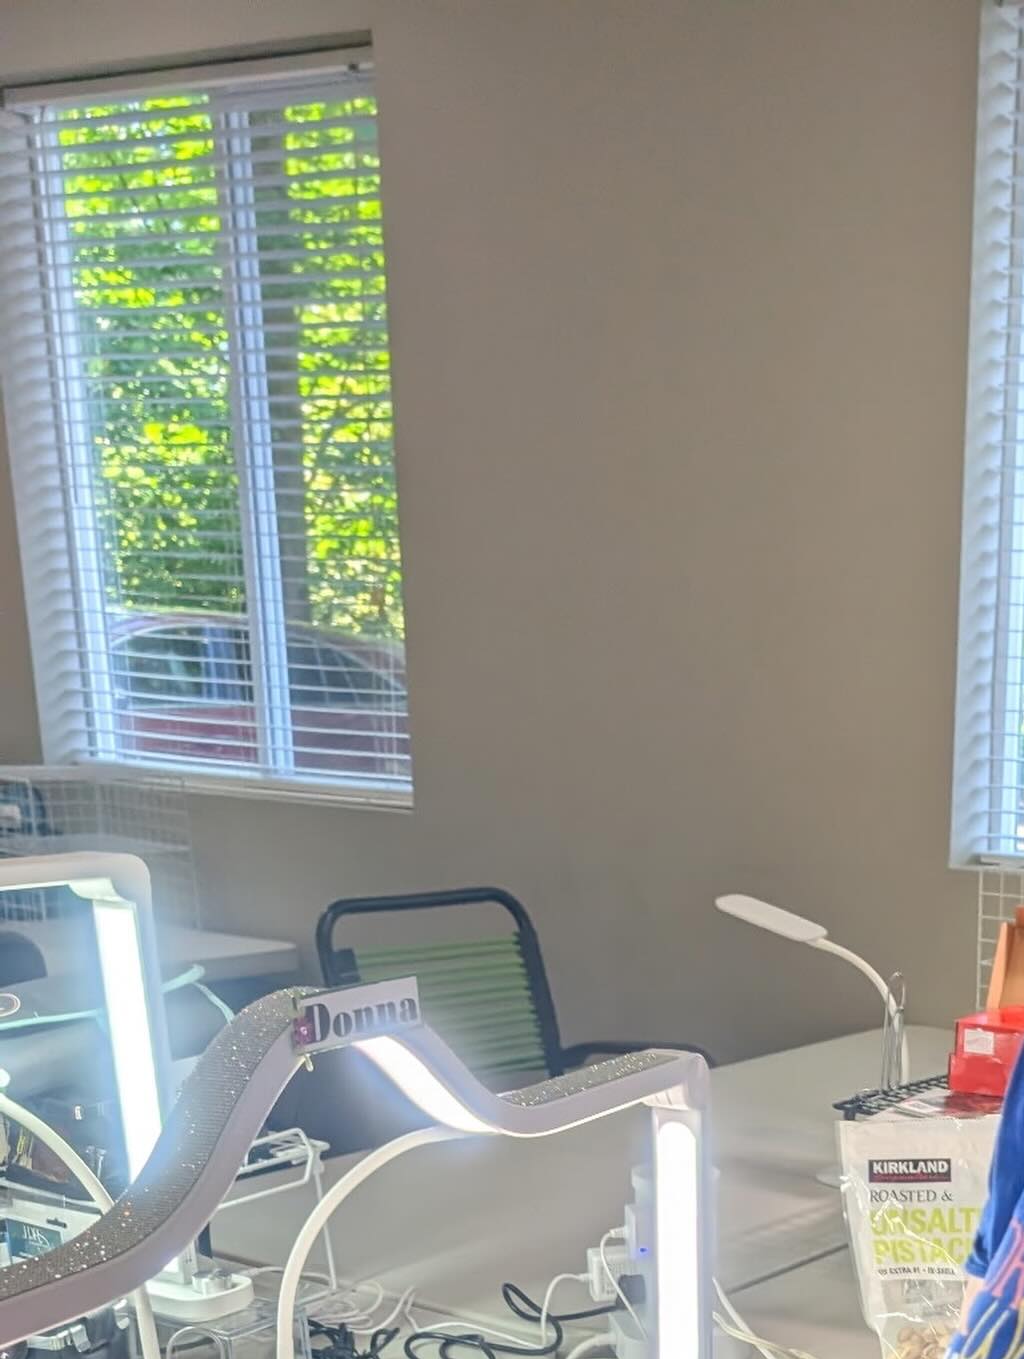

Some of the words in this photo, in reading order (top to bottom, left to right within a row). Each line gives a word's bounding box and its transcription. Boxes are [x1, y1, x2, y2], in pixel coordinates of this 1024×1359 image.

[305, 997, 419, 1042] Donna
[872, 1160, 949, 1174] KIRKLAND
[870, 1188, 937, 1203] ROASTED
[941, 1190, 953, 1201] &
[870, 1207, 982, 1236] UNSALT
[873, 1237, 972, 1264] PISTAC
